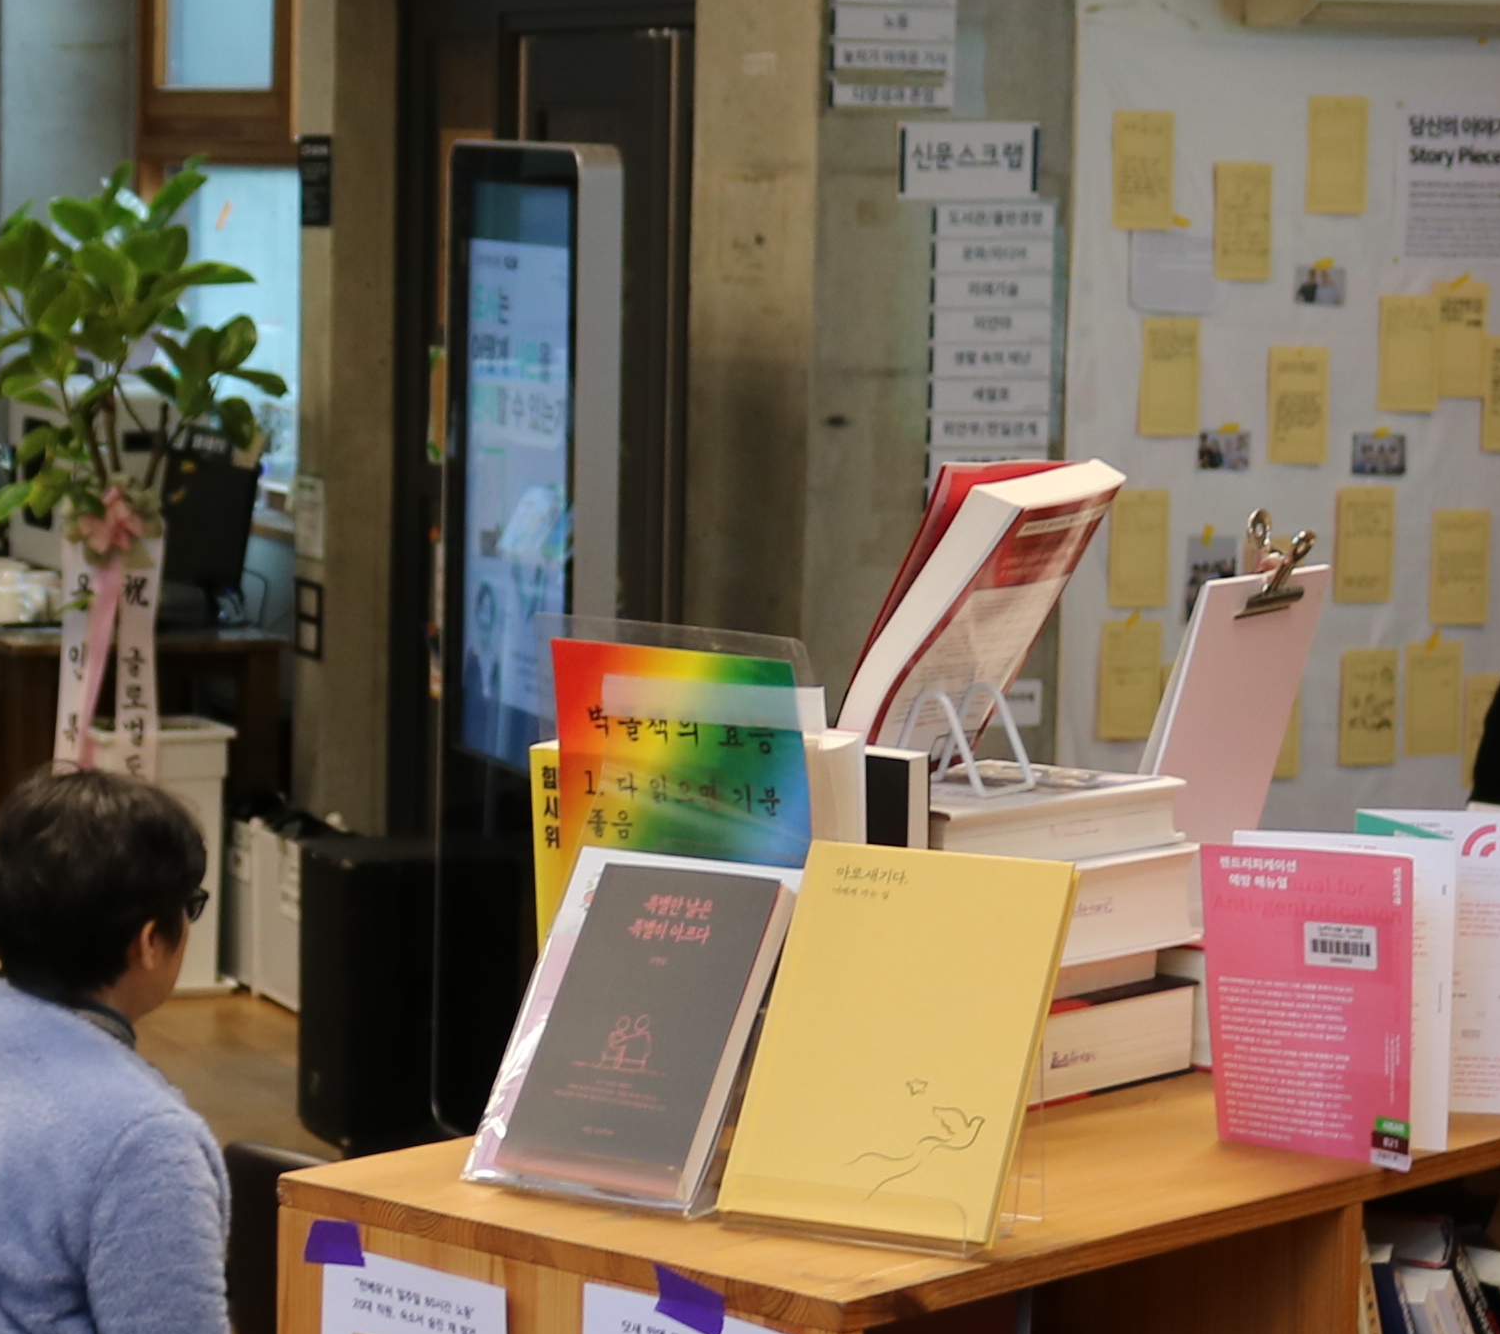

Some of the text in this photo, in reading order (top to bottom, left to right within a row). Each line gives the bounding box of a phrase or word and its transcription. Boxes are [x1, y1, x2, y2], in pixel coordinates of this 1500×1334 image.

[911, 139, 1024, 171] 신문스크랩
[1408, 144, 1454, 169] Story
[123, 573, 149, 607] 祝
[732, 783, 782, 817] 기분
